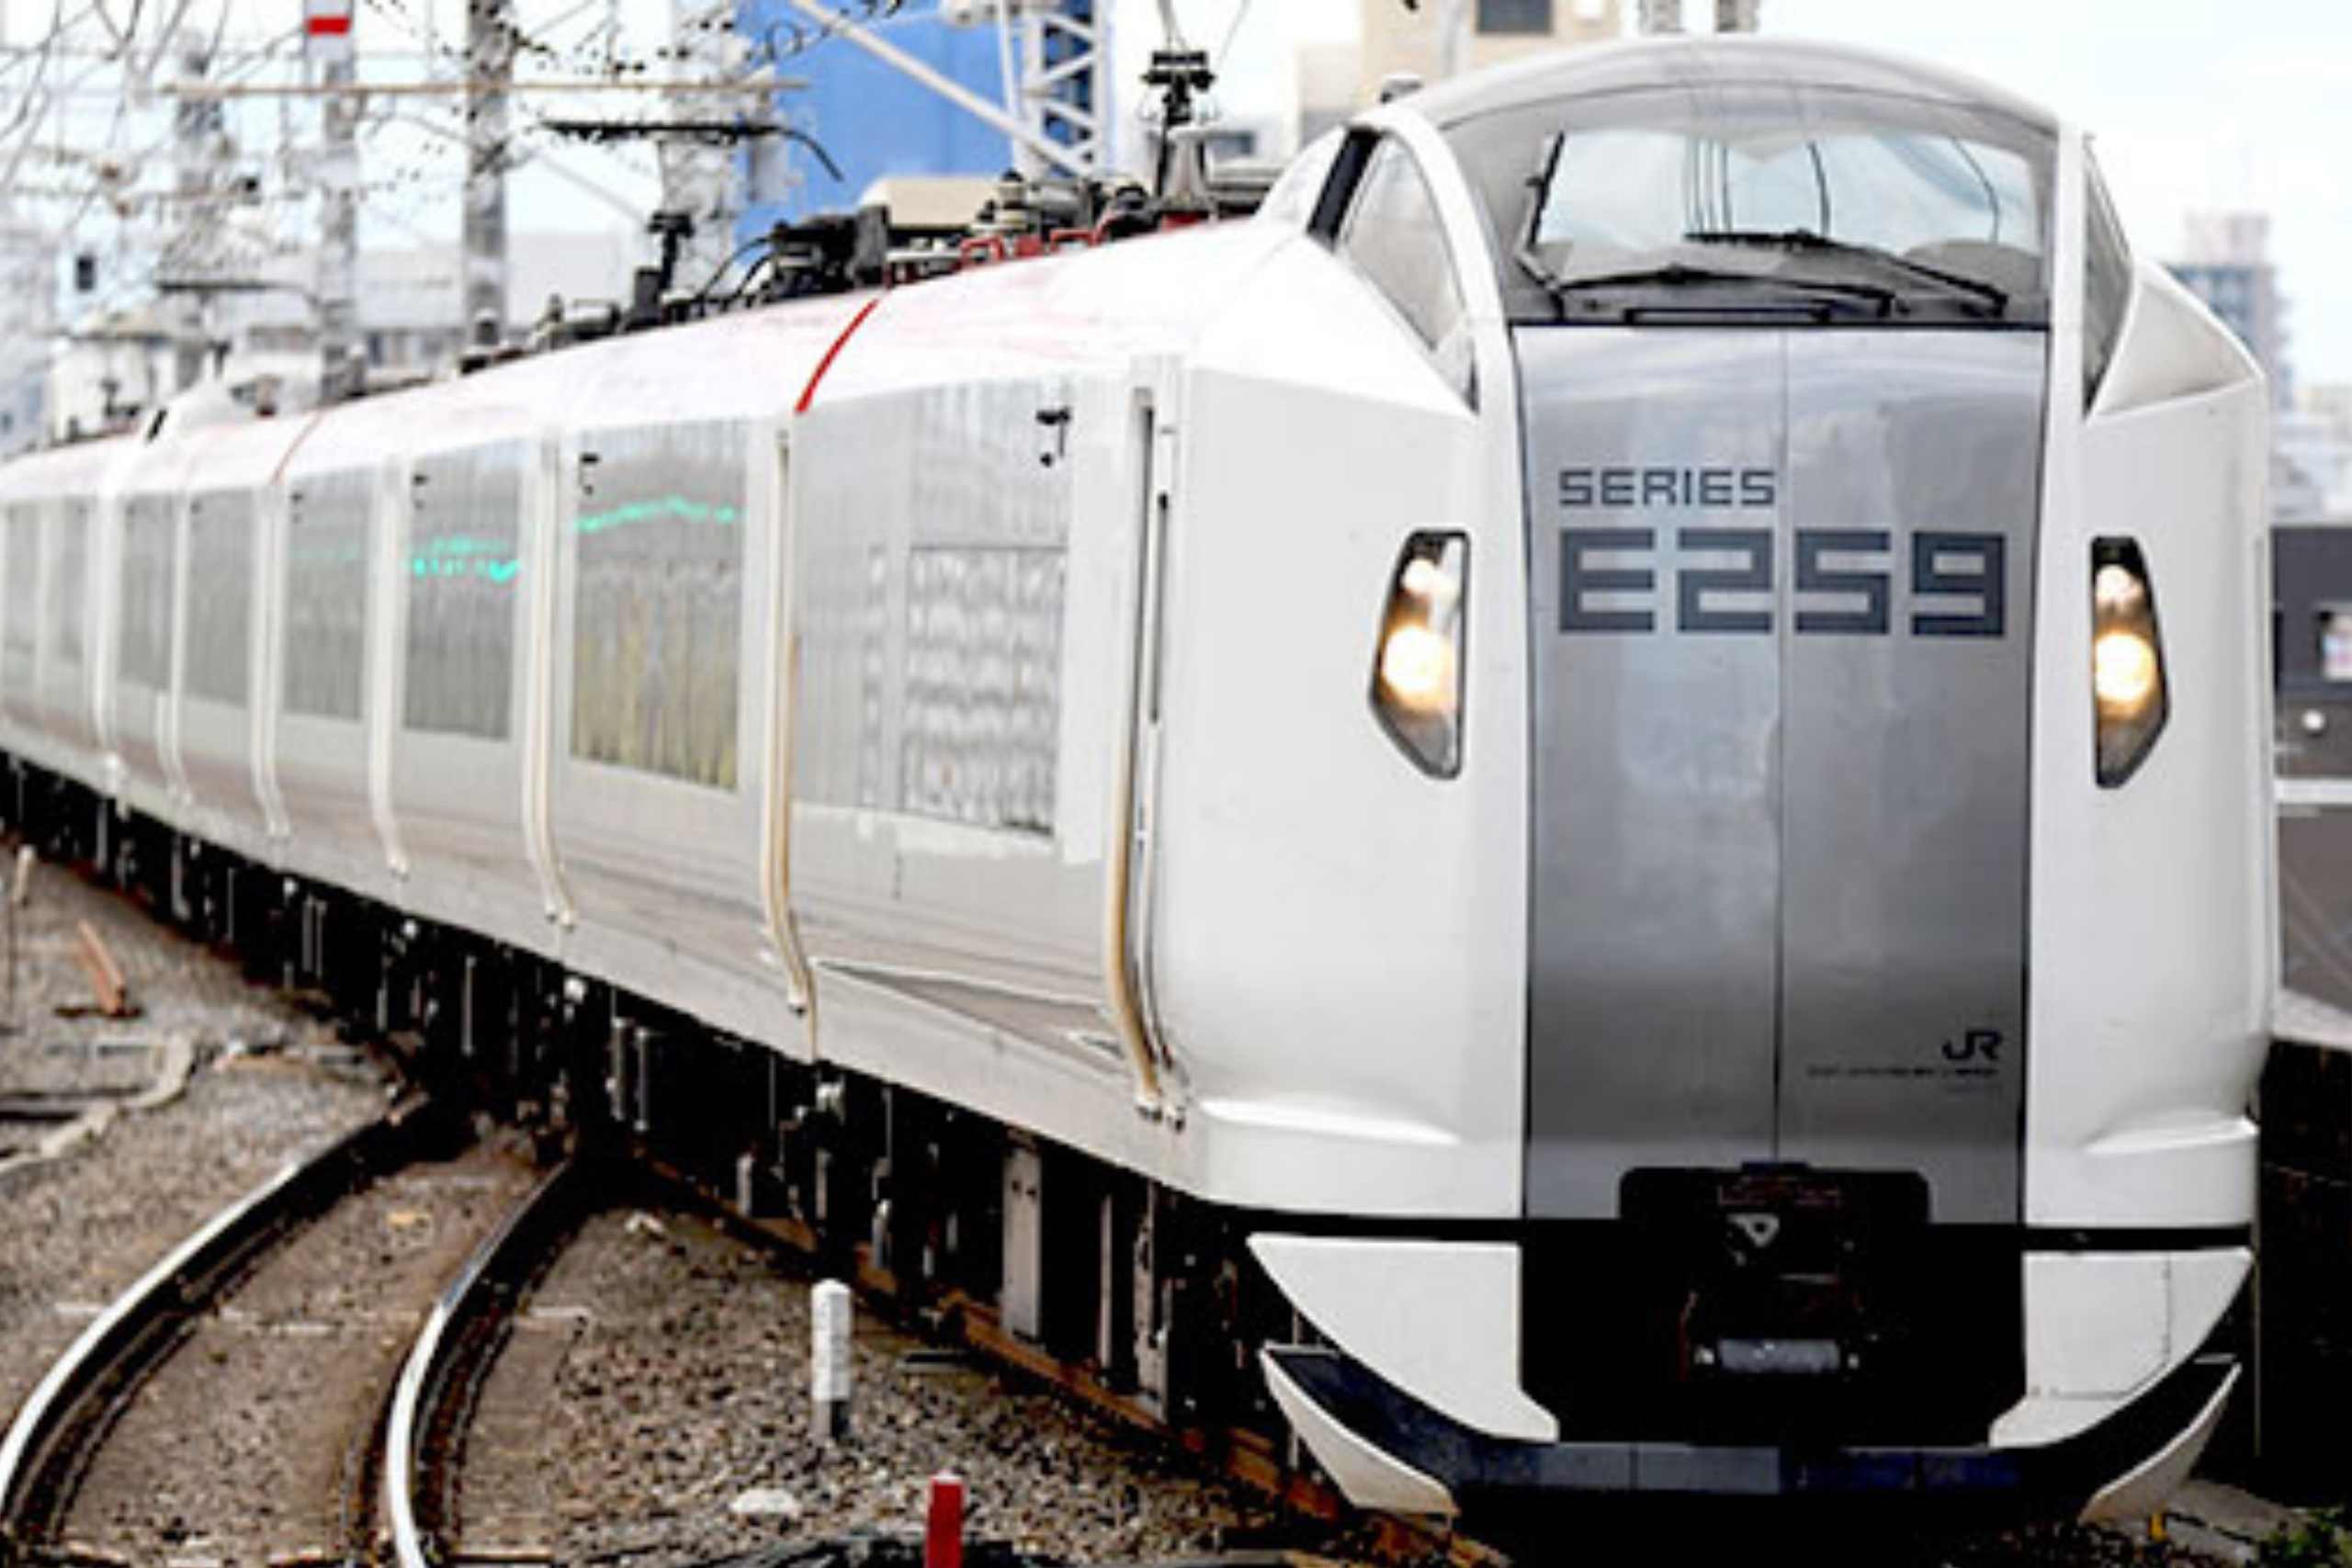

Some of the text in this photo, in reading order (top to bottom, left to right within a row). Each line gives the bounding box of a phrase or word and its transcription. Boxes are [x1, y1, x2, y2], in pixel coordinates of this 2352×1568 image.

[1559, 468, 1776, 507] SERIES
[1559, 528, 2006, 637] E259
[1941, 1030, 2001, 1060] JR
